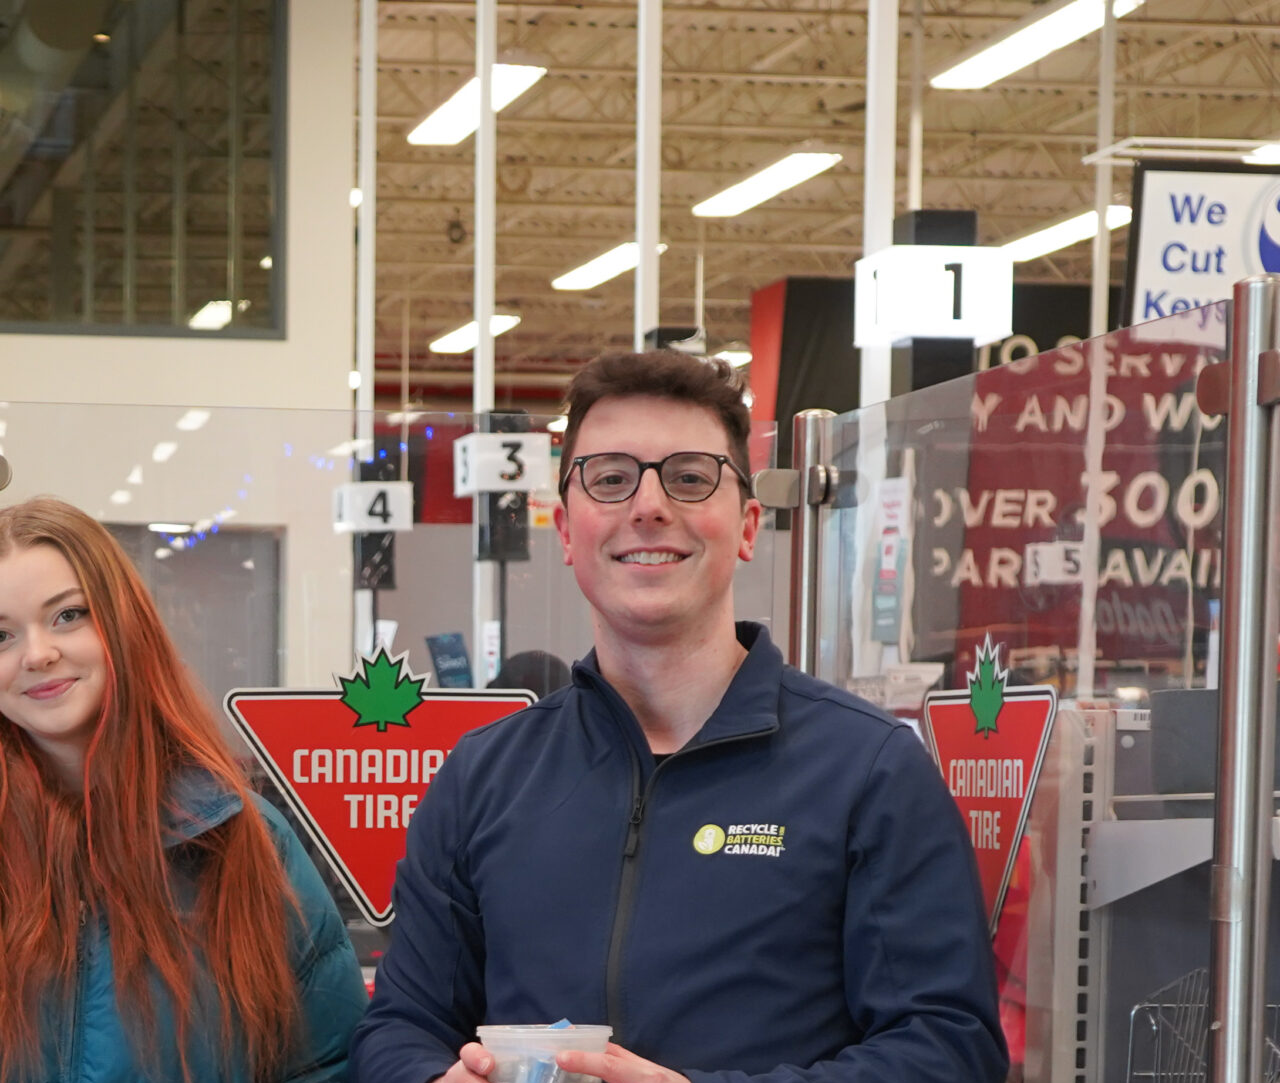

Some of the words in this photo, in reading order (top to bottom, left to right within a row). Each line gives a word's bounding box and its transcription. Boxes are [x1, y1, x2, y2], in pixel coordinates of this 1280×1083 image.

[1170, 193, 1226, 225] We
[1162, 242, 1226, 273] Cut
[944, 263, 962, 319] 1
[500, 441, 524, 481] 3
[368, 490, 392, 523] 4
[1076, 469, 1219, 530] 300
[293, 749, 455, 783] CANADIA
[949, 759, 1024, 798] CANADIAN
[726, 835, 783, 846] BATTERIES
[728, 824, 778, 835] RECYCLE
[969, 810, 1001, 850] TIRE
[724, 844, 781, 857] CANADA!
